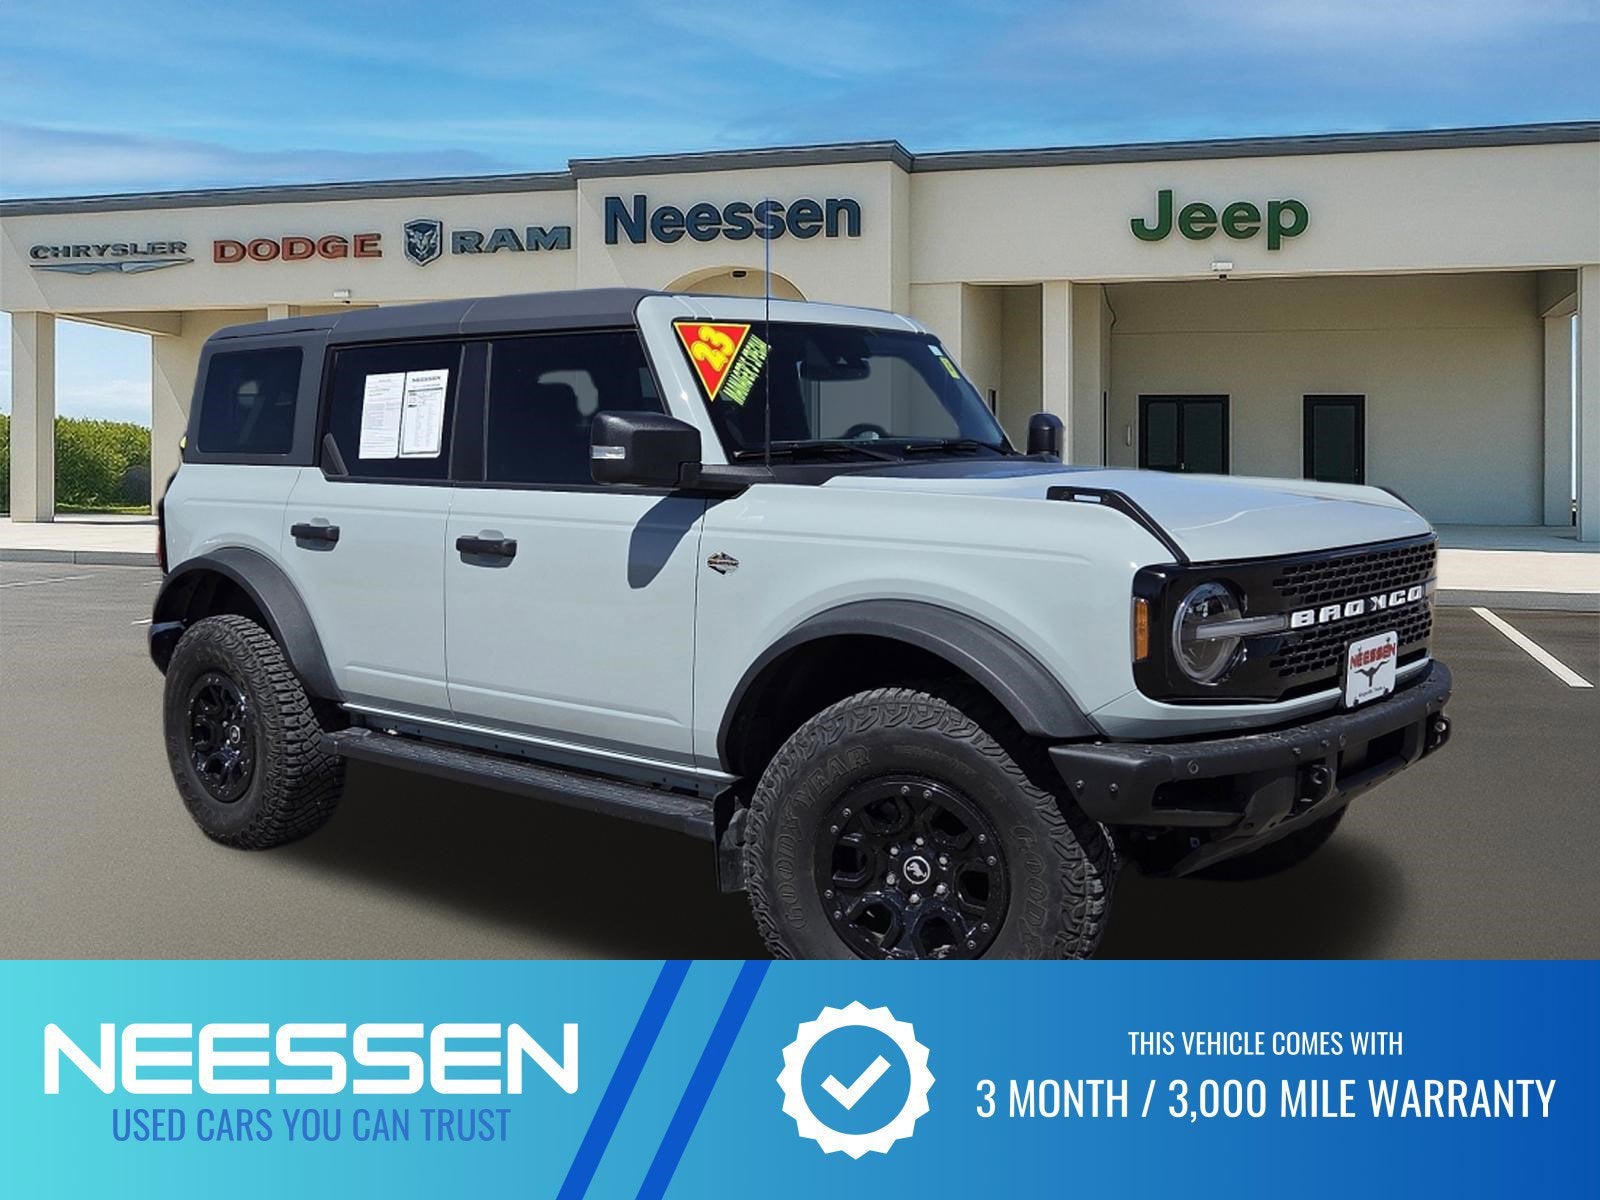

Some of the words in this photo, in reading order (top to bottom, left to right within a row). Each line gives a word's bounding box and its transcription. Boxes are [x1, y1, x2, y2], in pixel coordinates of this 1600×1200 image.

[604, 194, 862, 245] Neessen
[1130, 189, 1309, 251] Jeep
[29, 240, 188, 261] CHRYSLER
[213, 233, 382, 264] DODGE
[451, 225, 571, 255] RAM
[690, 325, 736, 372] 23
[1290, 585, 1424, 629] BRONCO
[1350, 643, 1396, 670] NEESSEN
